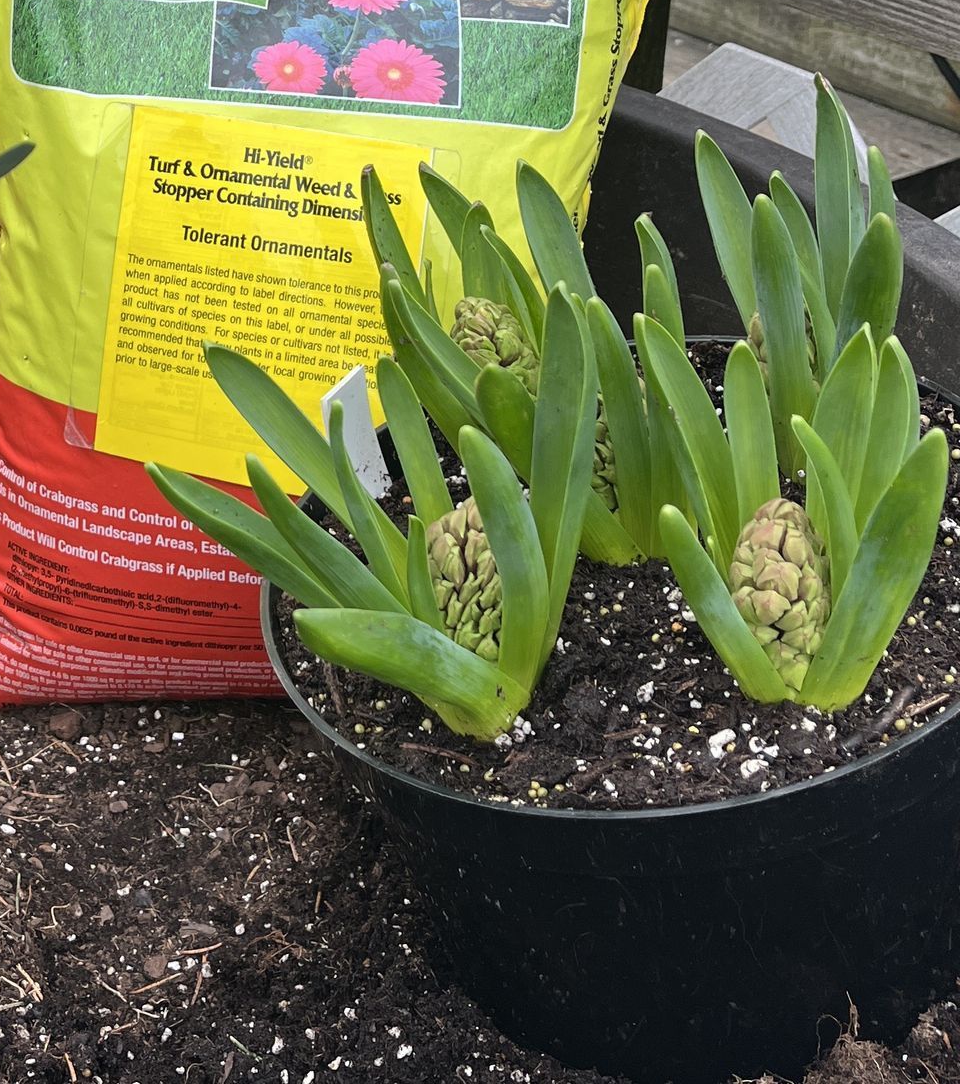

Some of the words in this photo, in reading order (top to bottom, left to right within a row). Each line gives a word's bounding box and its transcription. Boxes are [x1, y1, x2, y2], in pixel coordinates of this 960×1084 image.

[148, 156, 181, 175] Turf
[183, 161, 197, 178] &
[200, 163, 291, 189] Ornamental
[295, 176, 341, 198] Weed
[343, 184, 358, 200] &
[152, 179, 214, 205] Stopper
[217, 187, 300, 217] Containing
[302, 200, 366, 223] Dimensi
[182, 225, 247, 250] Tolerant
[251, 235, 353, 264] Ornamentals
[125, 268, 151, 280] when
[153, 273, 188, 288] applied
[190, 279, 236, 297] according
[252, 287, 276, 301] label
[278, 289, 326, 308] directions.
[334, 298, 377, 316] However,
[127, 252, 145, 266] The
[146, 257, 203, 275] ornamentals
[205, 265, 230, 279] listed
[232, 268, 255, 282] have
[256, 272, 287, 287] shown
[289, 276, 332, 294] tolerance
[344, 284, 362, 297] this
[123, 282, 159, 298] product
[163, 289, 180, 301] has
[184, 293, 200, 304] not
[204, 295, 228, 309] been
[232, 299, 262, 314] tested
[299, 310, 353, 326] ornamental
[136, 298, 175, 315] cultivars
[191, 307, 227, 324] species
[246, 314, 263, 328] this
[266, 319, 292, 335] label,
[309, 325, 336, 340] under
[339, 329, 351, 342] all
[118, 325, 183, 346] recommended
[185, 335, 204, 349] that
[284, 350, 317, 366] limited
[318, 357, 339, 371] area
[120, 310, 157, 328] growing
[159, 316, 209, 335] conditions.
[214, 326, 231, 339] For
[232, 329, 268, 345] species
[283, 334, 323, 353] cultivars
[325, 341, 340, 355] not
[115, 352, 137, 366] prior
[149, 358, 200, 378] large-scale
[116, 338, 134, 351] and
[136, 343, 178, 360] observed
[273, 365, 296, 379] local
[298, 369, 337, 388] growing
[17, 491, 80, 531] Ornamental
[82, 518, 152, 548] Landscape
[154, 534, 198, 555] Areas,
[26, 480, 38, 495] of
[38, 484, 99, 516] Crabgrass
[101, 502, 127, 520] and
[128, 507, 178, 531] Control
[2, 508, 36, 543] Product
[37, 532, 56, 550] Will
[58, 537, 98, 563] Control
[100, 549, 164, 578] Crabgrass
[177, 564, 227, 585] Applied
[228, 570, 263, 586] Befor
